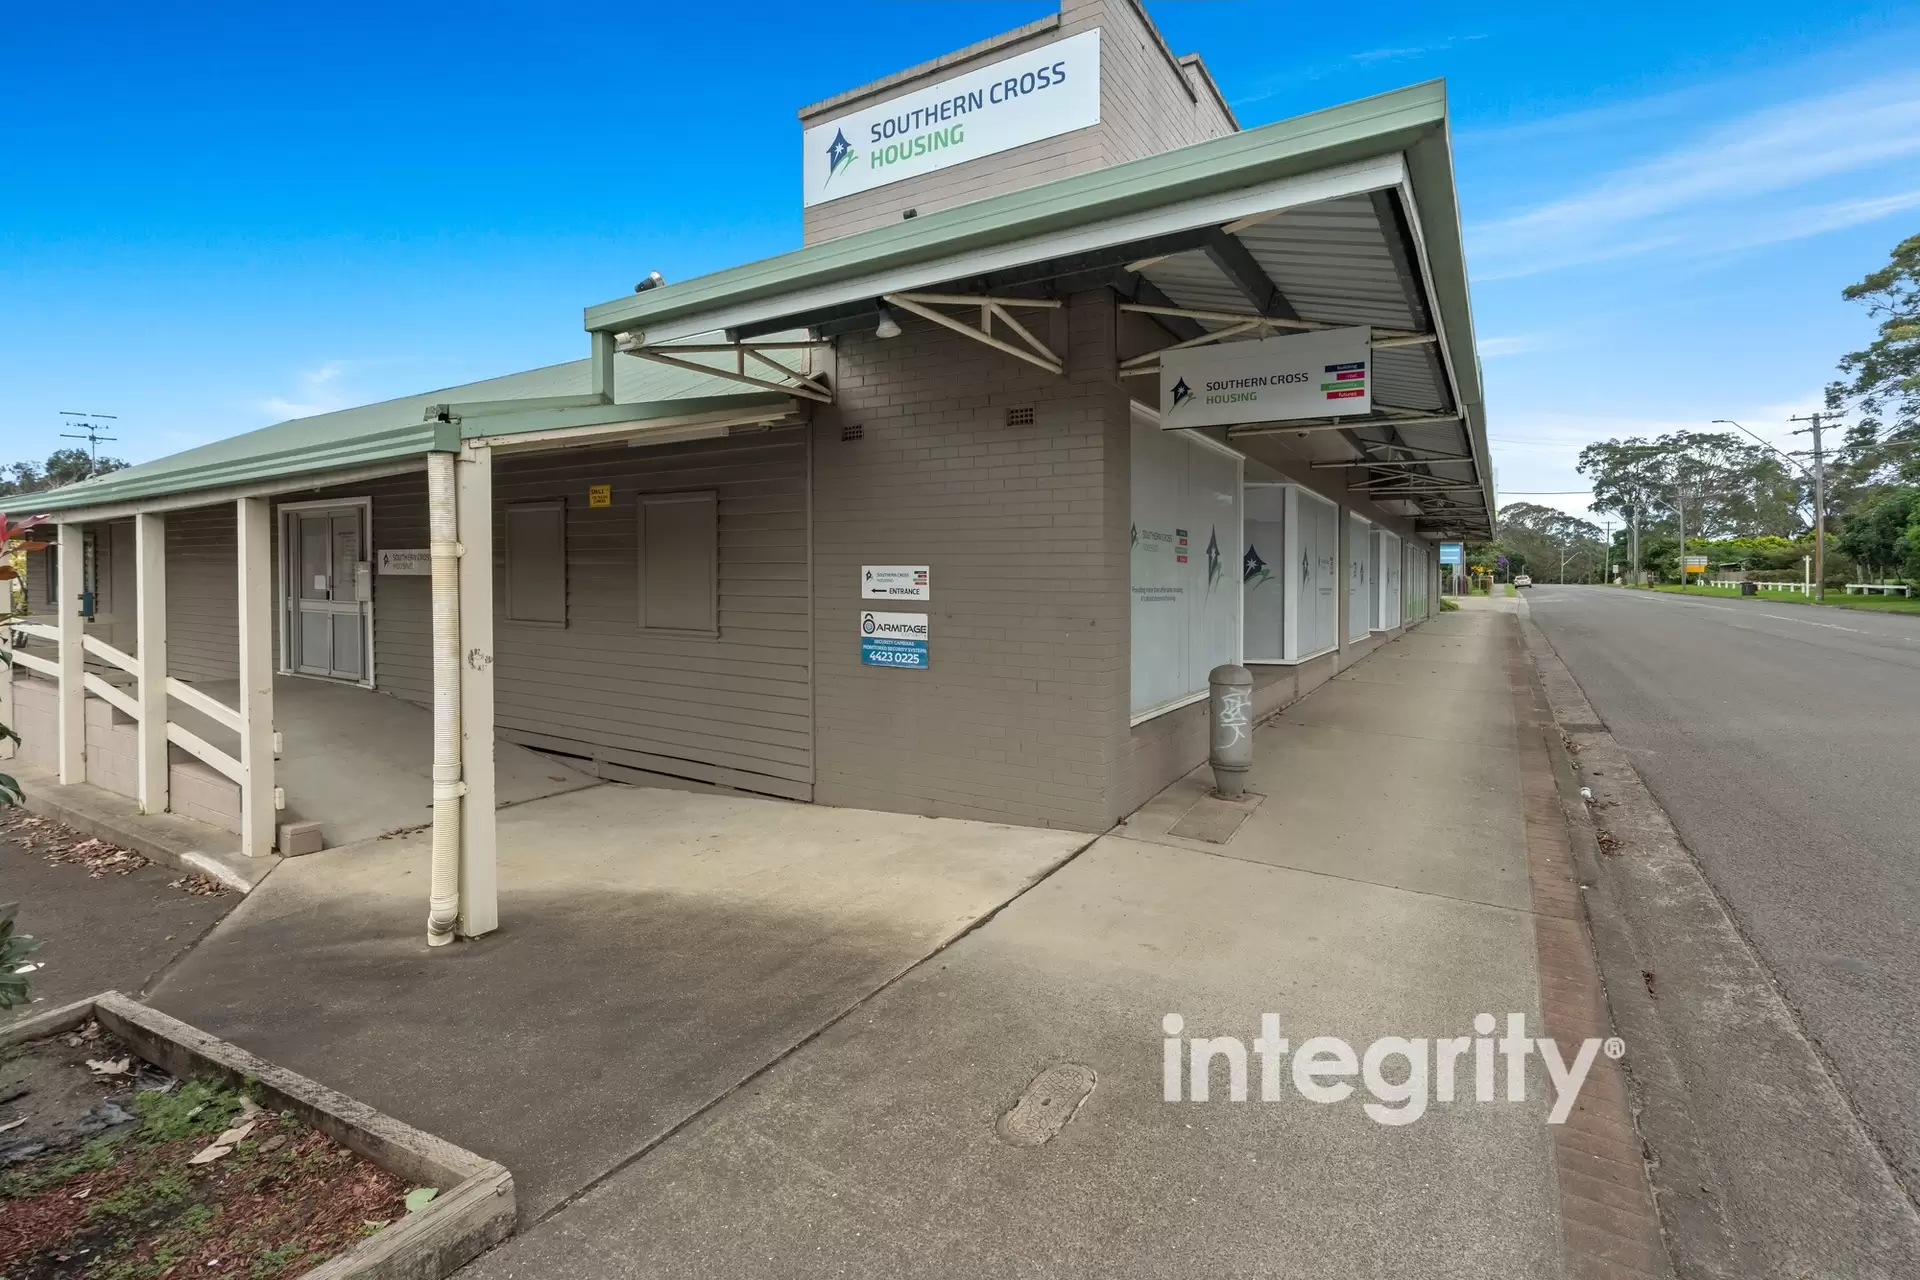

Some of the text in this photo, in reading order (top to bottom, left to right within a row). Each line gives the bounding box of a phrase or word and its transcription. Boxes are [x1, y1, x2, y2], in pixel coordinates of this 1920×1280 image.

[871, 61, 1066, 143] SOUTHERN CROSS
[871, 124, 964, 169] HOUSING
[1206, 372, 1309, 391] SOUTHERN CROSS
[1206, 392, 1257, 404] HOUSING
[877, 624, 927, 633] ARMITAGE
[869, 651, 920, 664] 4423 0225
